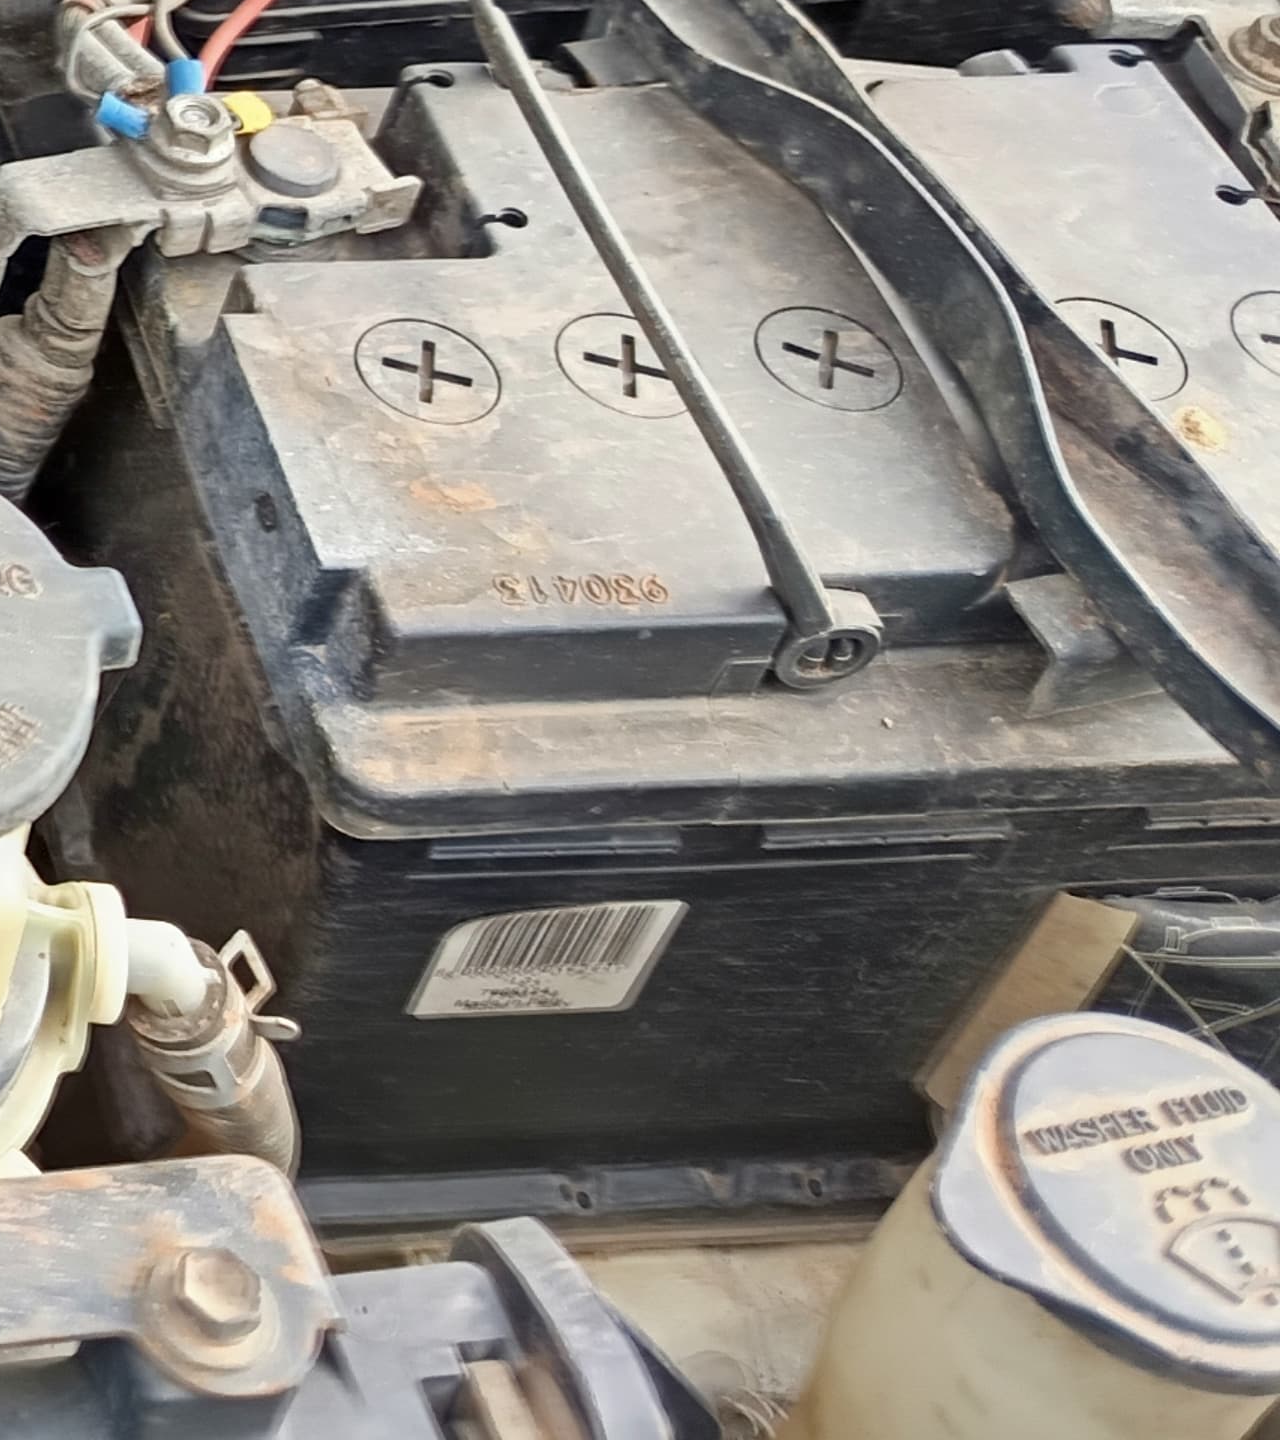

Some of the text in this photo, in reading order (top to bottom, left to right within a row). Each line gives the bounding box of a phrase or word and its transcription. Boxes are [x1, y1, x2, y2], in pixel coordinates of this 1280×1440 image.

[1023, 1086, 1250, 1157] WASHER FLUID
[1121, 1134, 1204, 1174] ONLY
